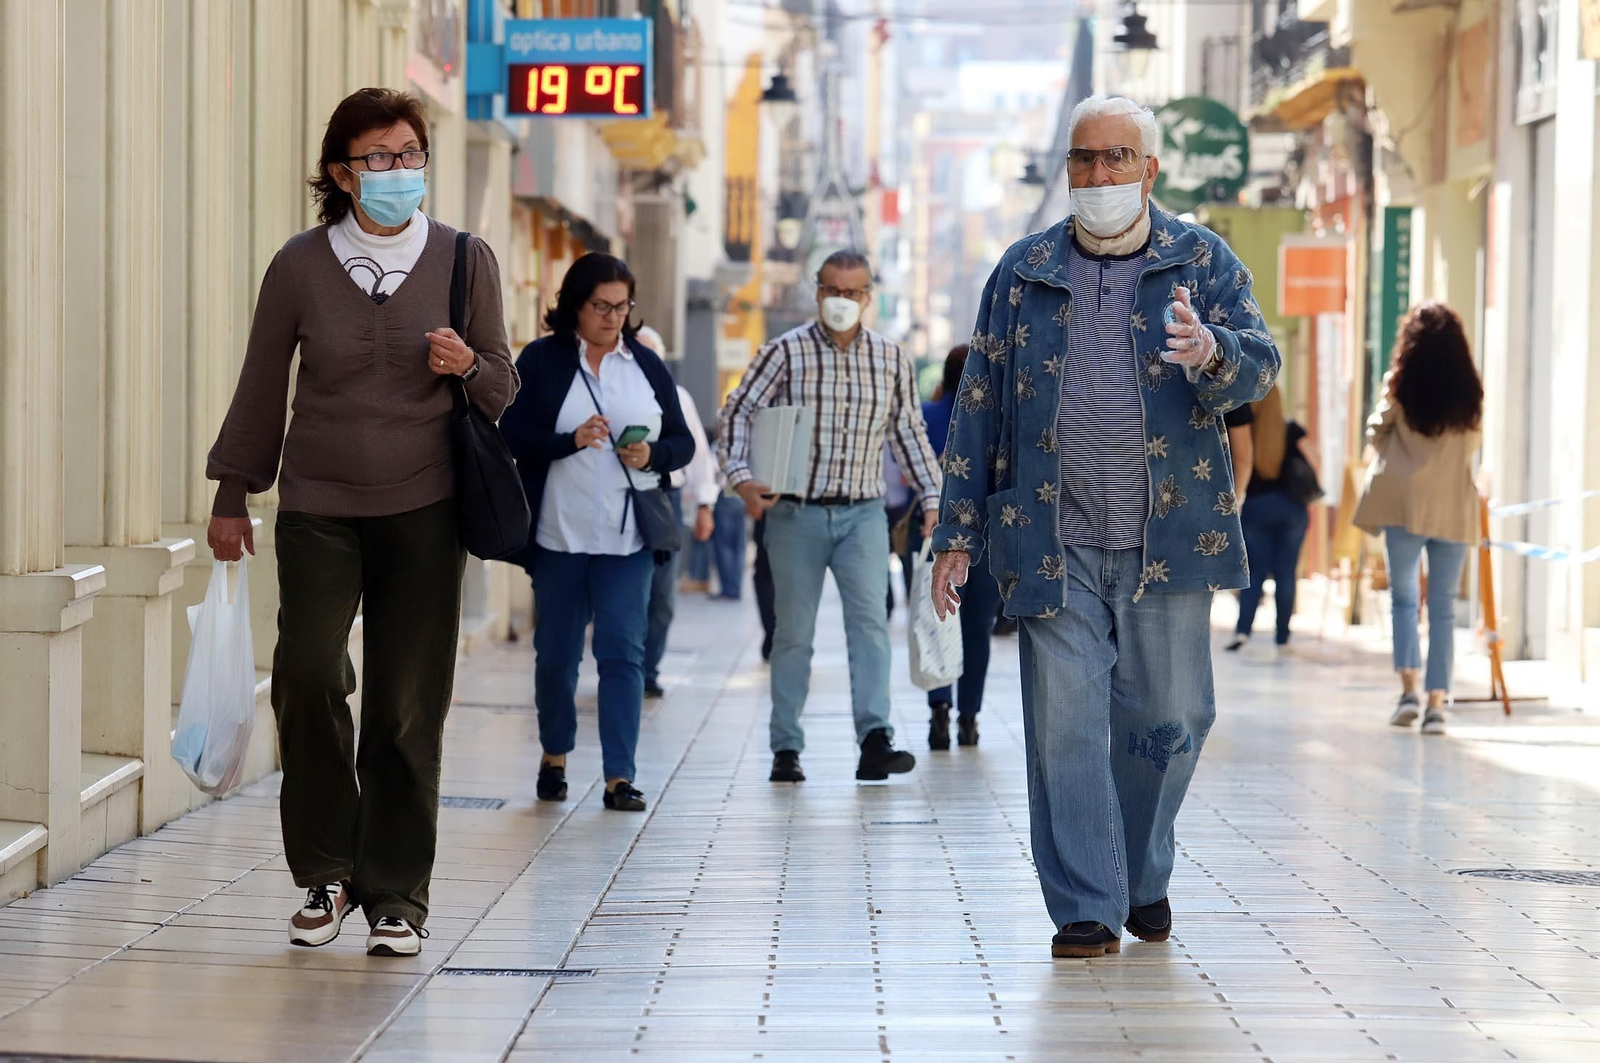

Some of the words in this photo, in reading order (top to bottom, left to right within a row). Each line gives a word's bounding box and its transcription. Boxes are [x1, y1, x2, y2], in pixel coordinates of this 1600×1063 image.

[509, 30, 571, 56] optica
[575, 30, 642, 51] urbano
[527, 65, 568, 114] 19
